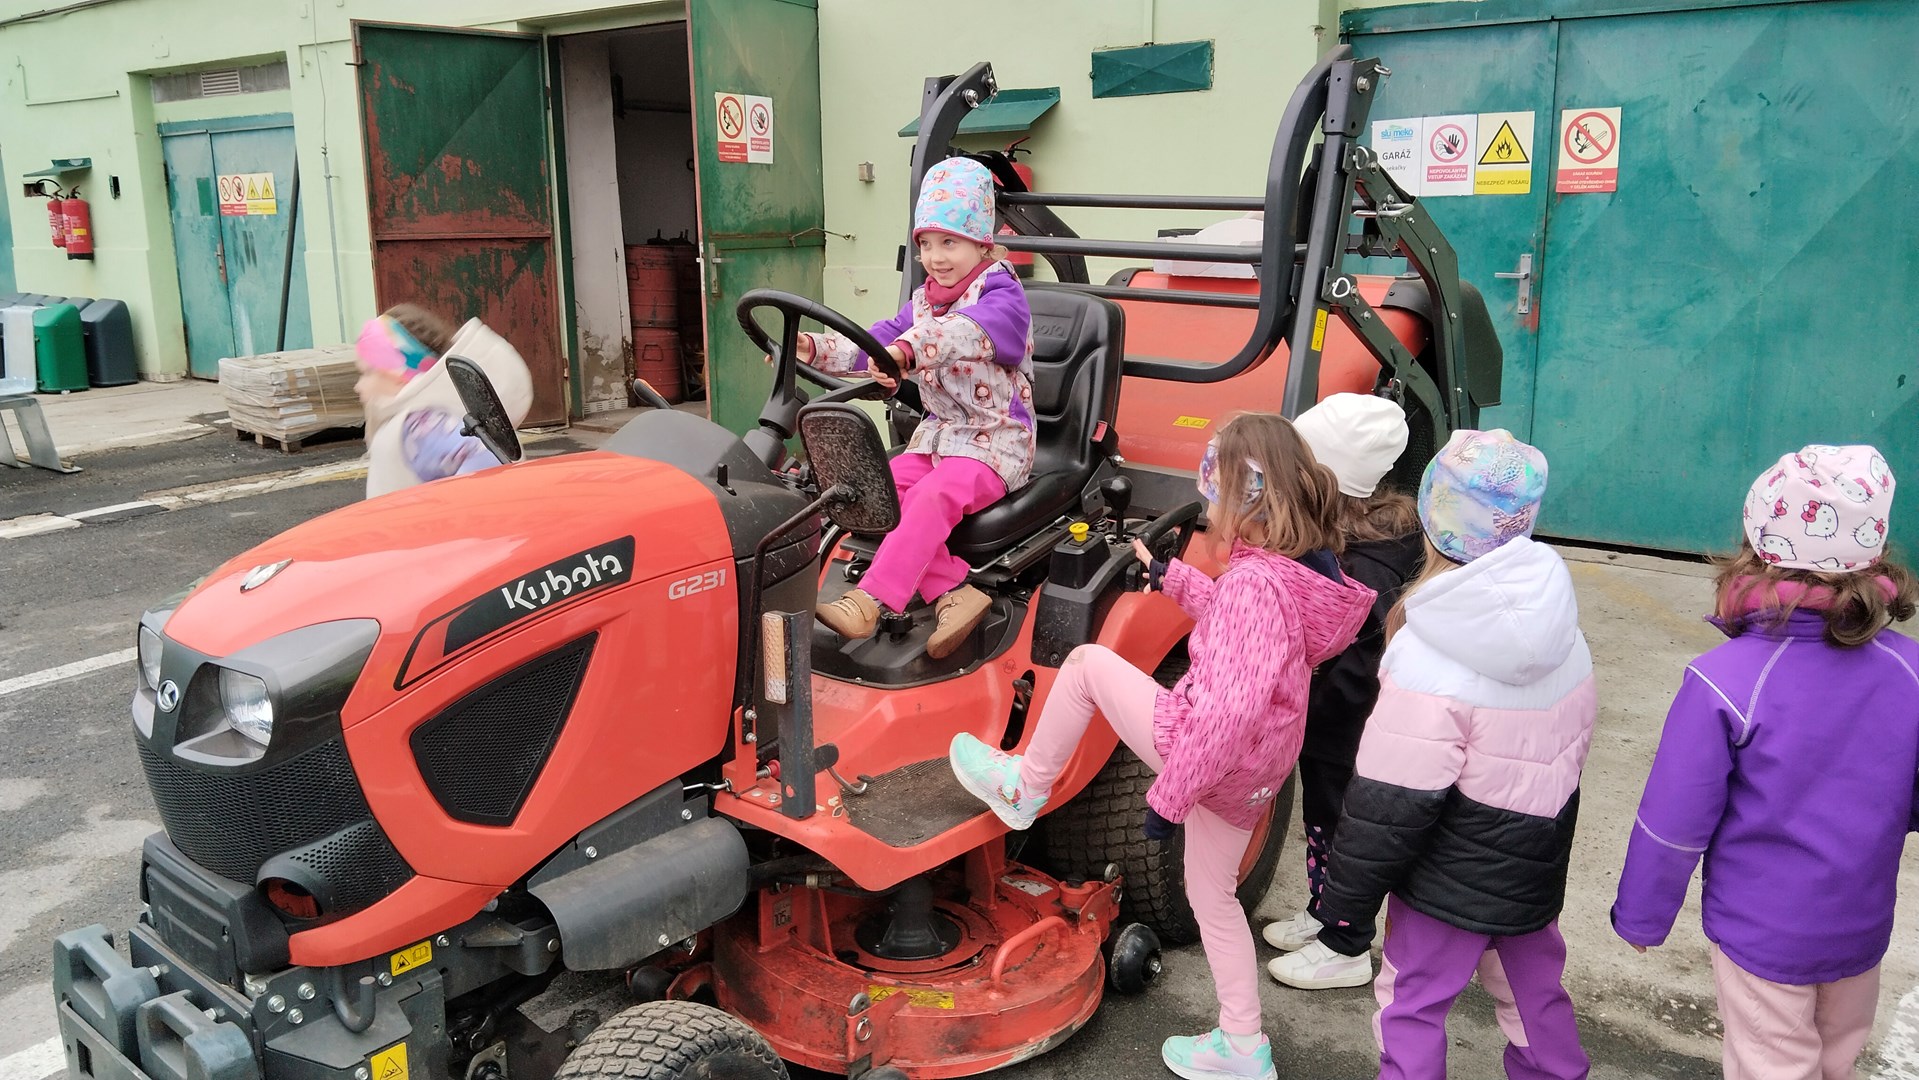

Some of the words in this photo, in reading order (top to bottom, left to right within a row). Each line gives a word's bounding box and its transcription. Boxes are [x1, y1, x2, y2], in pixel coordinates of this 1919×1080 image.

[1382, 149, 1411, 160] GARÁŽ
[501, 553, 624, 610] Kubota
[668, 568, 727, 601] G231
